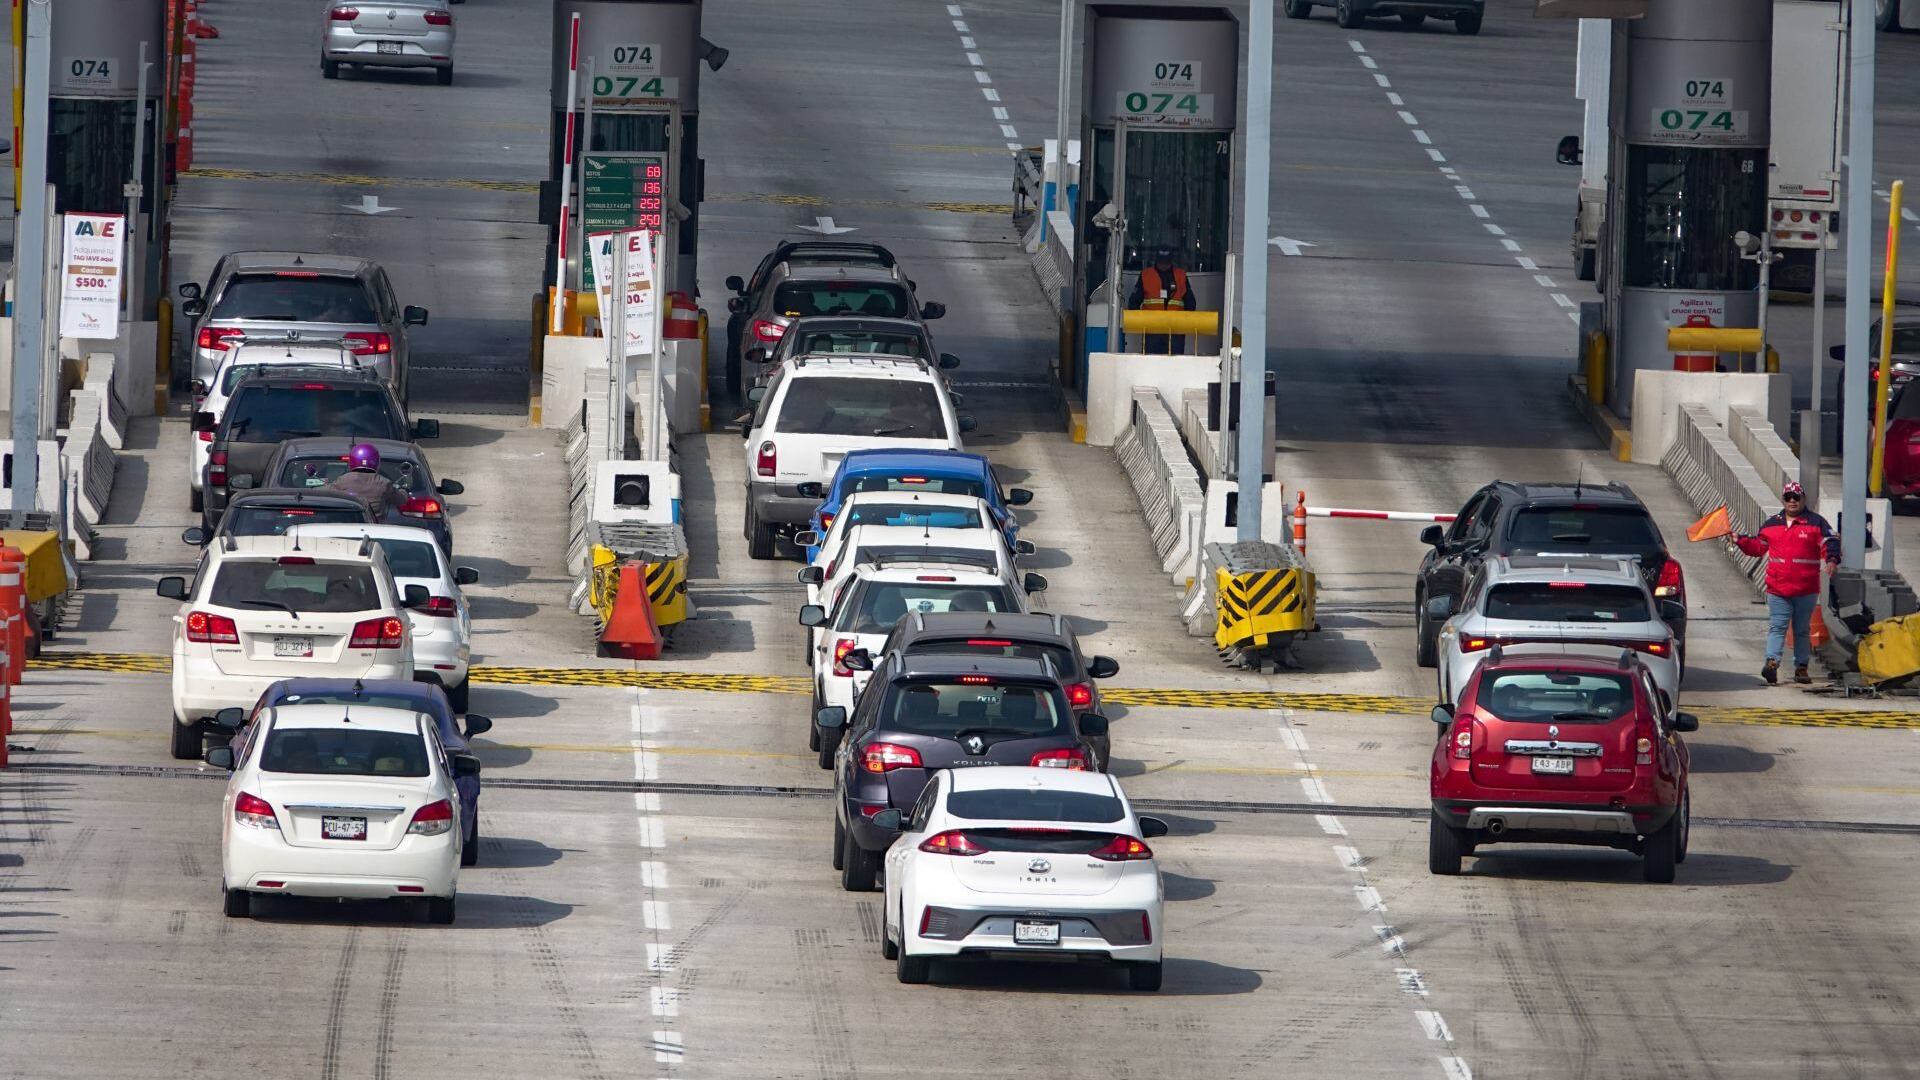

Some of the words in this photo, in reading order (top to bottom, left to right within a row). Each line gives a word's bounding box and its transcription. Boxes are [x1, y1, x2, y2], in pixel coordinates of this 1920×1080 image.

[614, 46, 653, 64] 074
[71, 60, 110, 77] 074
[1155, 62, 1193, 80] 074
[592, 76, 665, 97] 074
[1686, 80, 1724, 98] 074
[1125, 92, 1200, 114] 074
[1660, 109, 1734, 131] 074
[646, 166, 661, 178] 68
[643, 182, 661, 194] 136
[640, 198, 661, 209] 252
[75, 220, 115, 238] IAVE
[640, 214, 661, 226] 250
[1680, 299, 1704, 307] Agiliza
